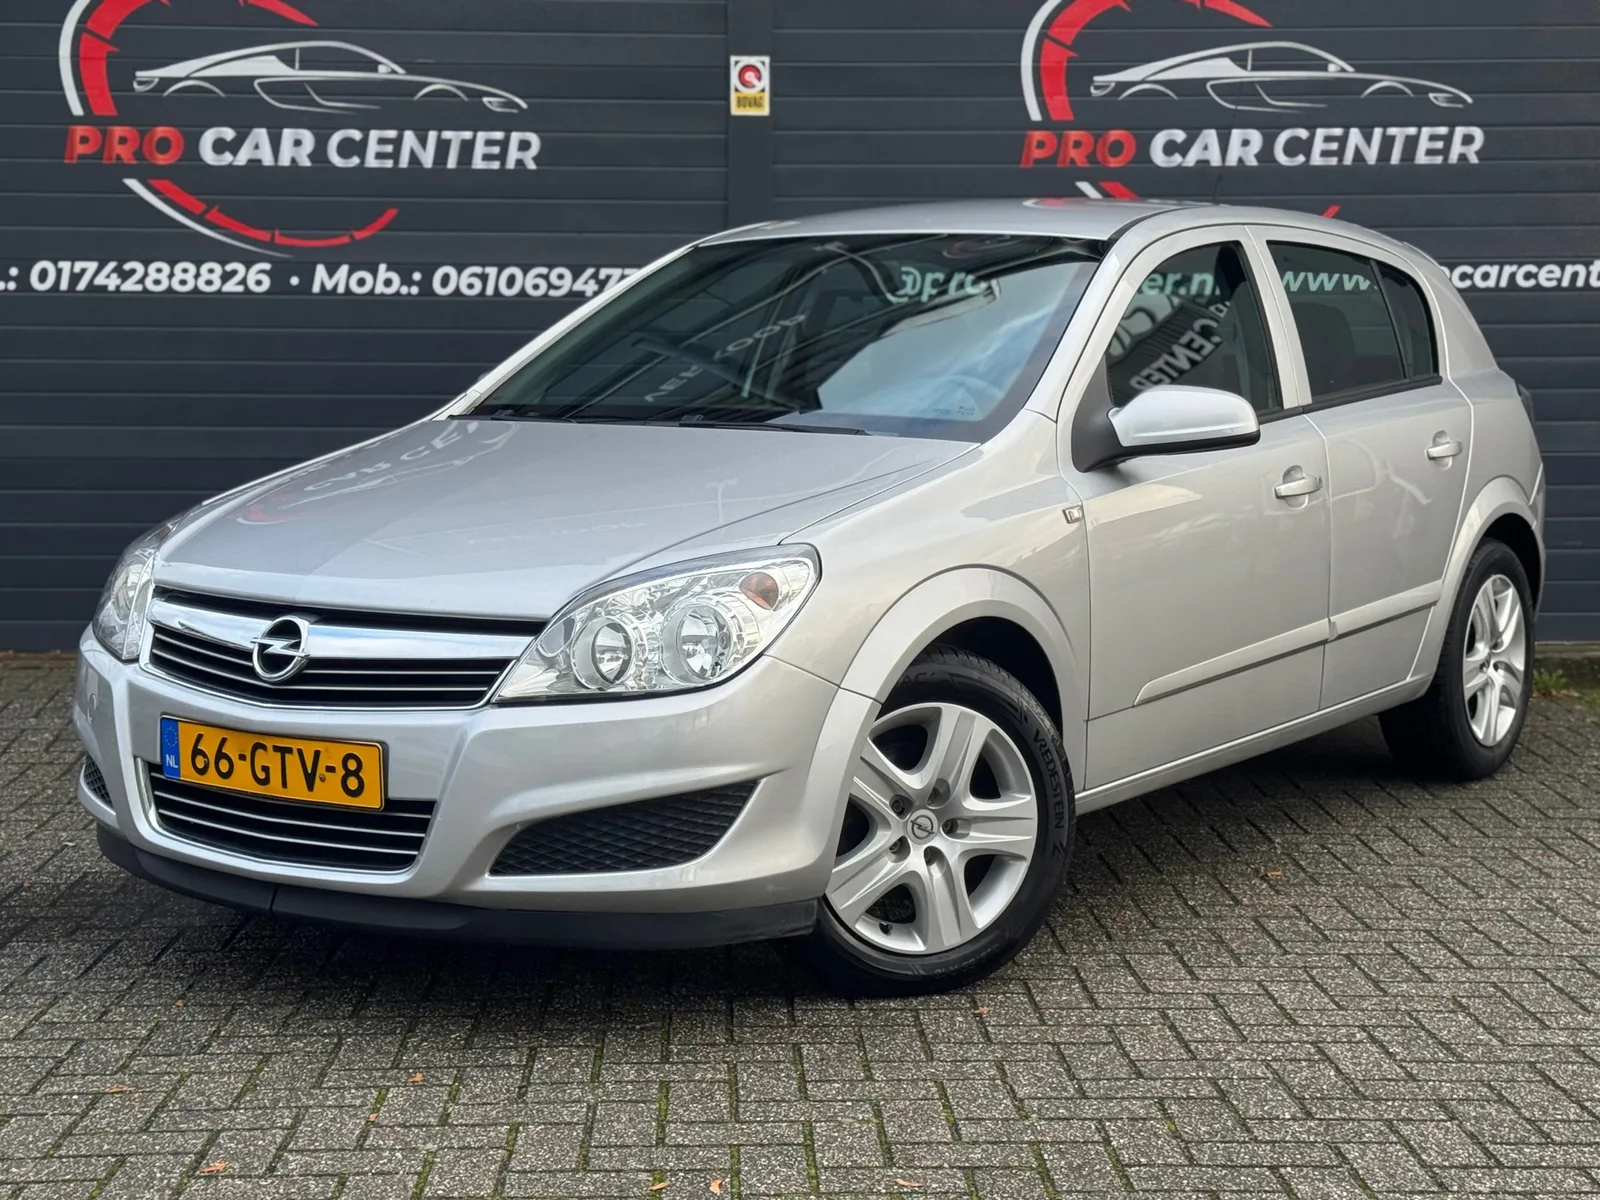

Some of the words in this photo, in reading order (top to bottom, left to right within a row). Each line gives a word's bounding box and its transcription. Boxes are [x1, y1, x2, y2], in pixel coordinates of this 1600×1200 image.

[63, 125, 185, 165] PRO
[198, 127, 315, 168] CAR
[326, 130, 542, 170] CENTER
[1020, 129, 1137, 168] PRO
[1149, 127, 1263, 167] CAR
[1273, 126, 1485, 165] CENTER
[30, 260, 272, 293] 0174288826
[312, 264, 422, 295] Mob.:
[165, 753, 179, 769] NL
[190, 733, 365, 798] 66-GTV-8
[1032, 728, 1065, 829] VREDESTEIN
